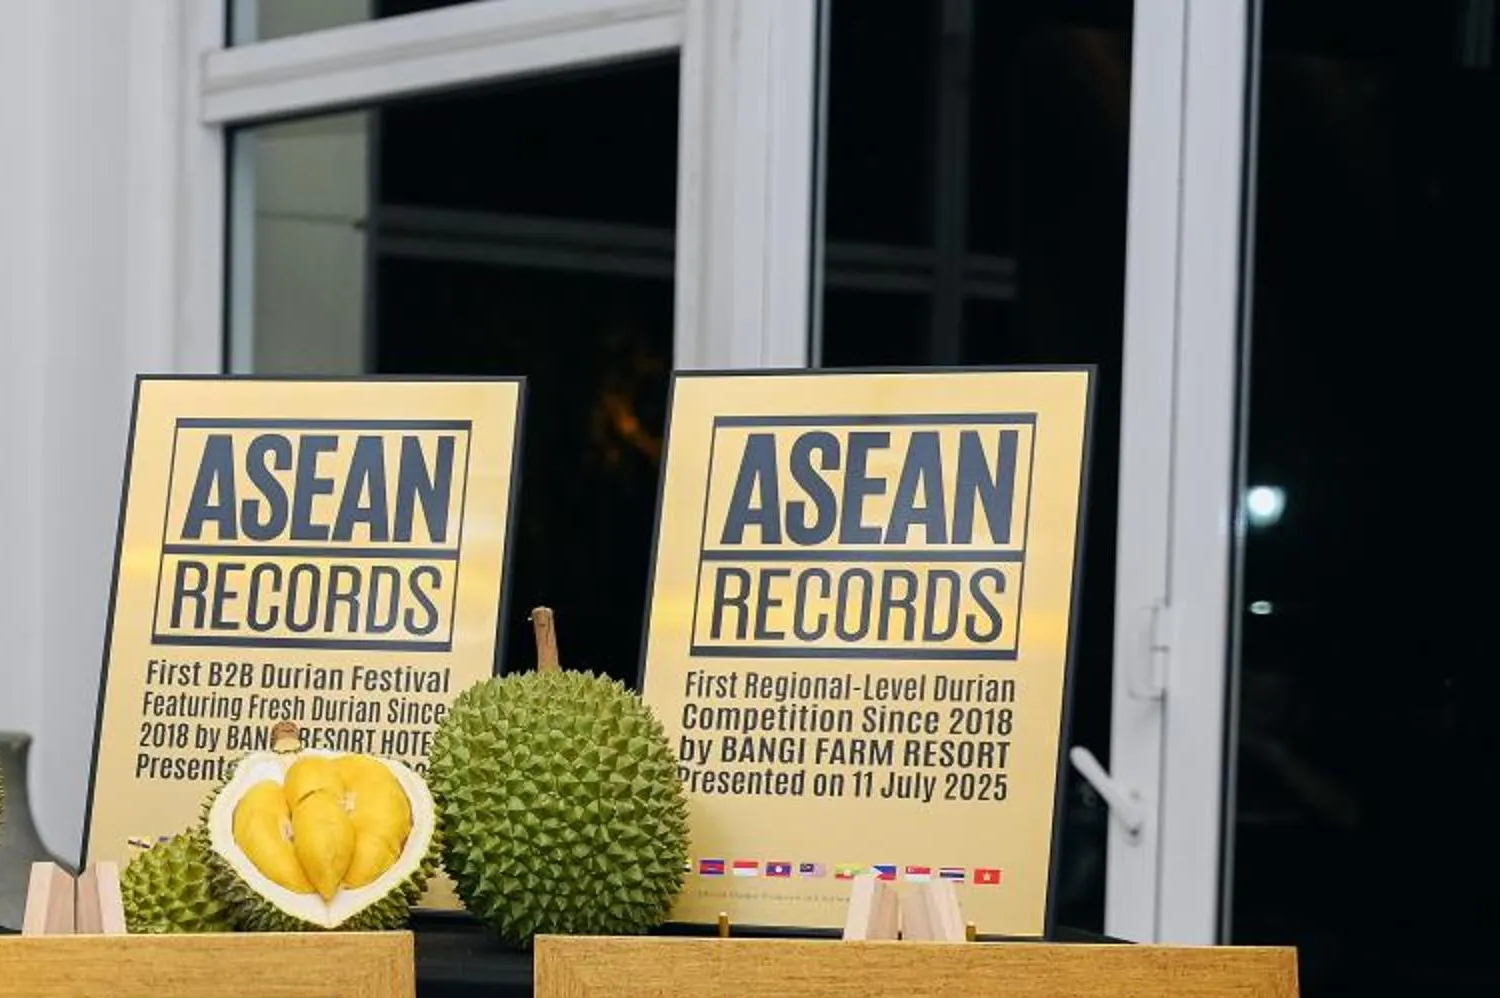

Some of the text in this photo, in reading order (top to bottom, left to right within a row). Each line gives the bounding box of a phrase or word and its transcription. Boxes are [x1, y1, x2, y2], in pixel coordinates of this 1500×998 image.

[181, 434, 457, 543] ASEAN
[720, 430, 1019, 546] ASEAN
[170, 561, 442, 636] RECORDS
[709, 567, 1006, 644] RECORDS
[146, 660, 451, 693] First B2B Durian Festival
[685, 670, 1015, 703] First Regional-Level Durian
[142, 692, 446, 724] Featuring Fresh Durian Since
[682, 703, 1013, 736] Competition Since 2018
[140, 722, 432, 757] 2018 by BAN RESORT HOTE
[680, 736, 1011, 768] by BANGI FARM RESORT
[136, 753, 226, 781] Present
[678, 766, 1007, 803] Presented on 11 July 2025
